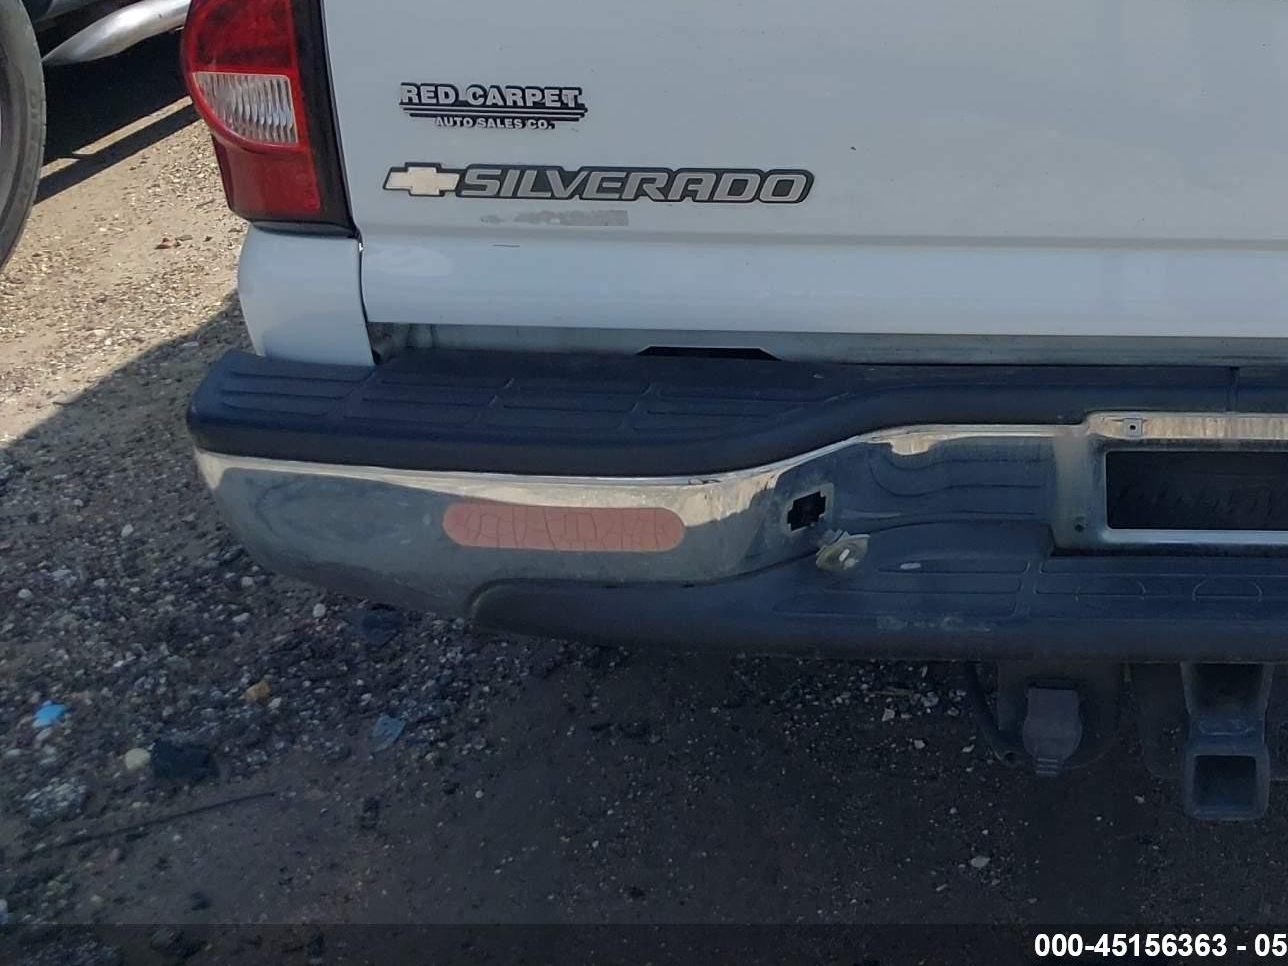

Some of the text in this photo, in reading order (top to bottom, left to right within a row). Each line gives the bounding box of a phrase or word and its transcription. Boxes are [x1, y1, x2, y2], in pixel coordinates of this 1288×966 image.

[399, 83, 582, 108] RED CARPET
[435, 116, 474, 128] AUTO
[476, 117, 523, 130] SALES
[459, 167, 811, 203] SILVERADO
